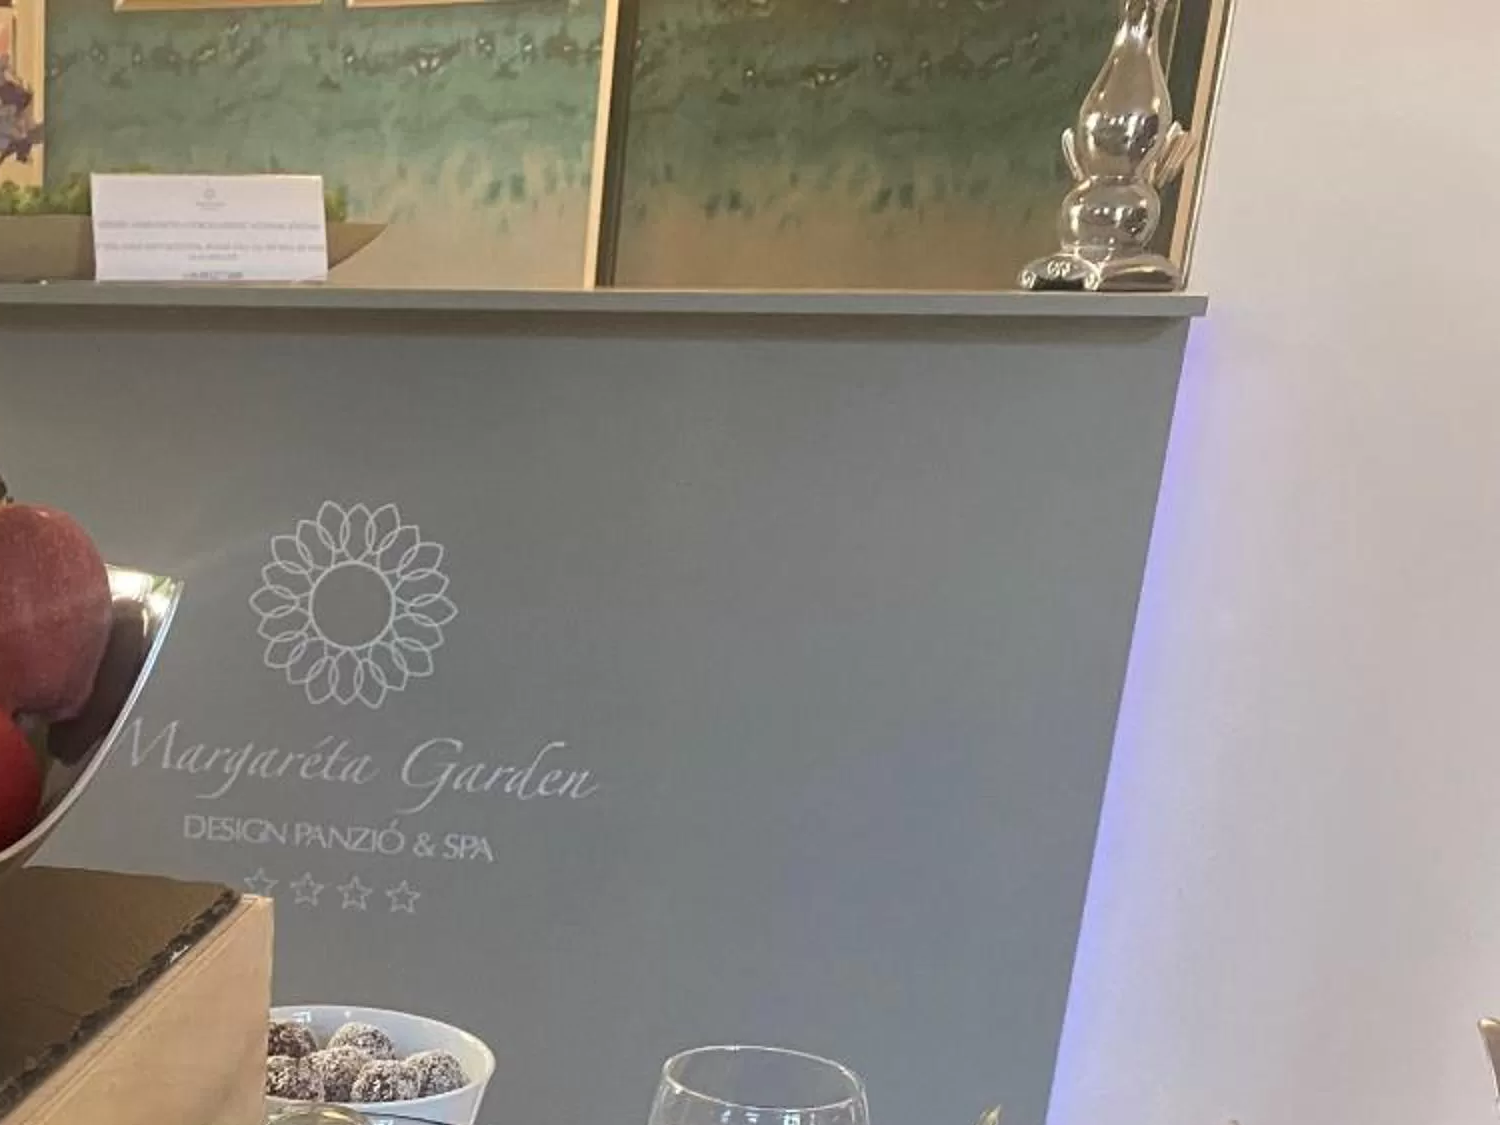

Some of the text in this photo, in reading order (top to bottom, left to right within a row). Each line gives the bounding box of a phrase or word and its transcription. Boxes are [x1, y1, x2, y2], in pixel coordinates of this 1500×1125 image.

[106, 716, 599, 814] Margaréta Garden
[183, 815, 495, 863] DESIGN PANZIÓ & SPA
